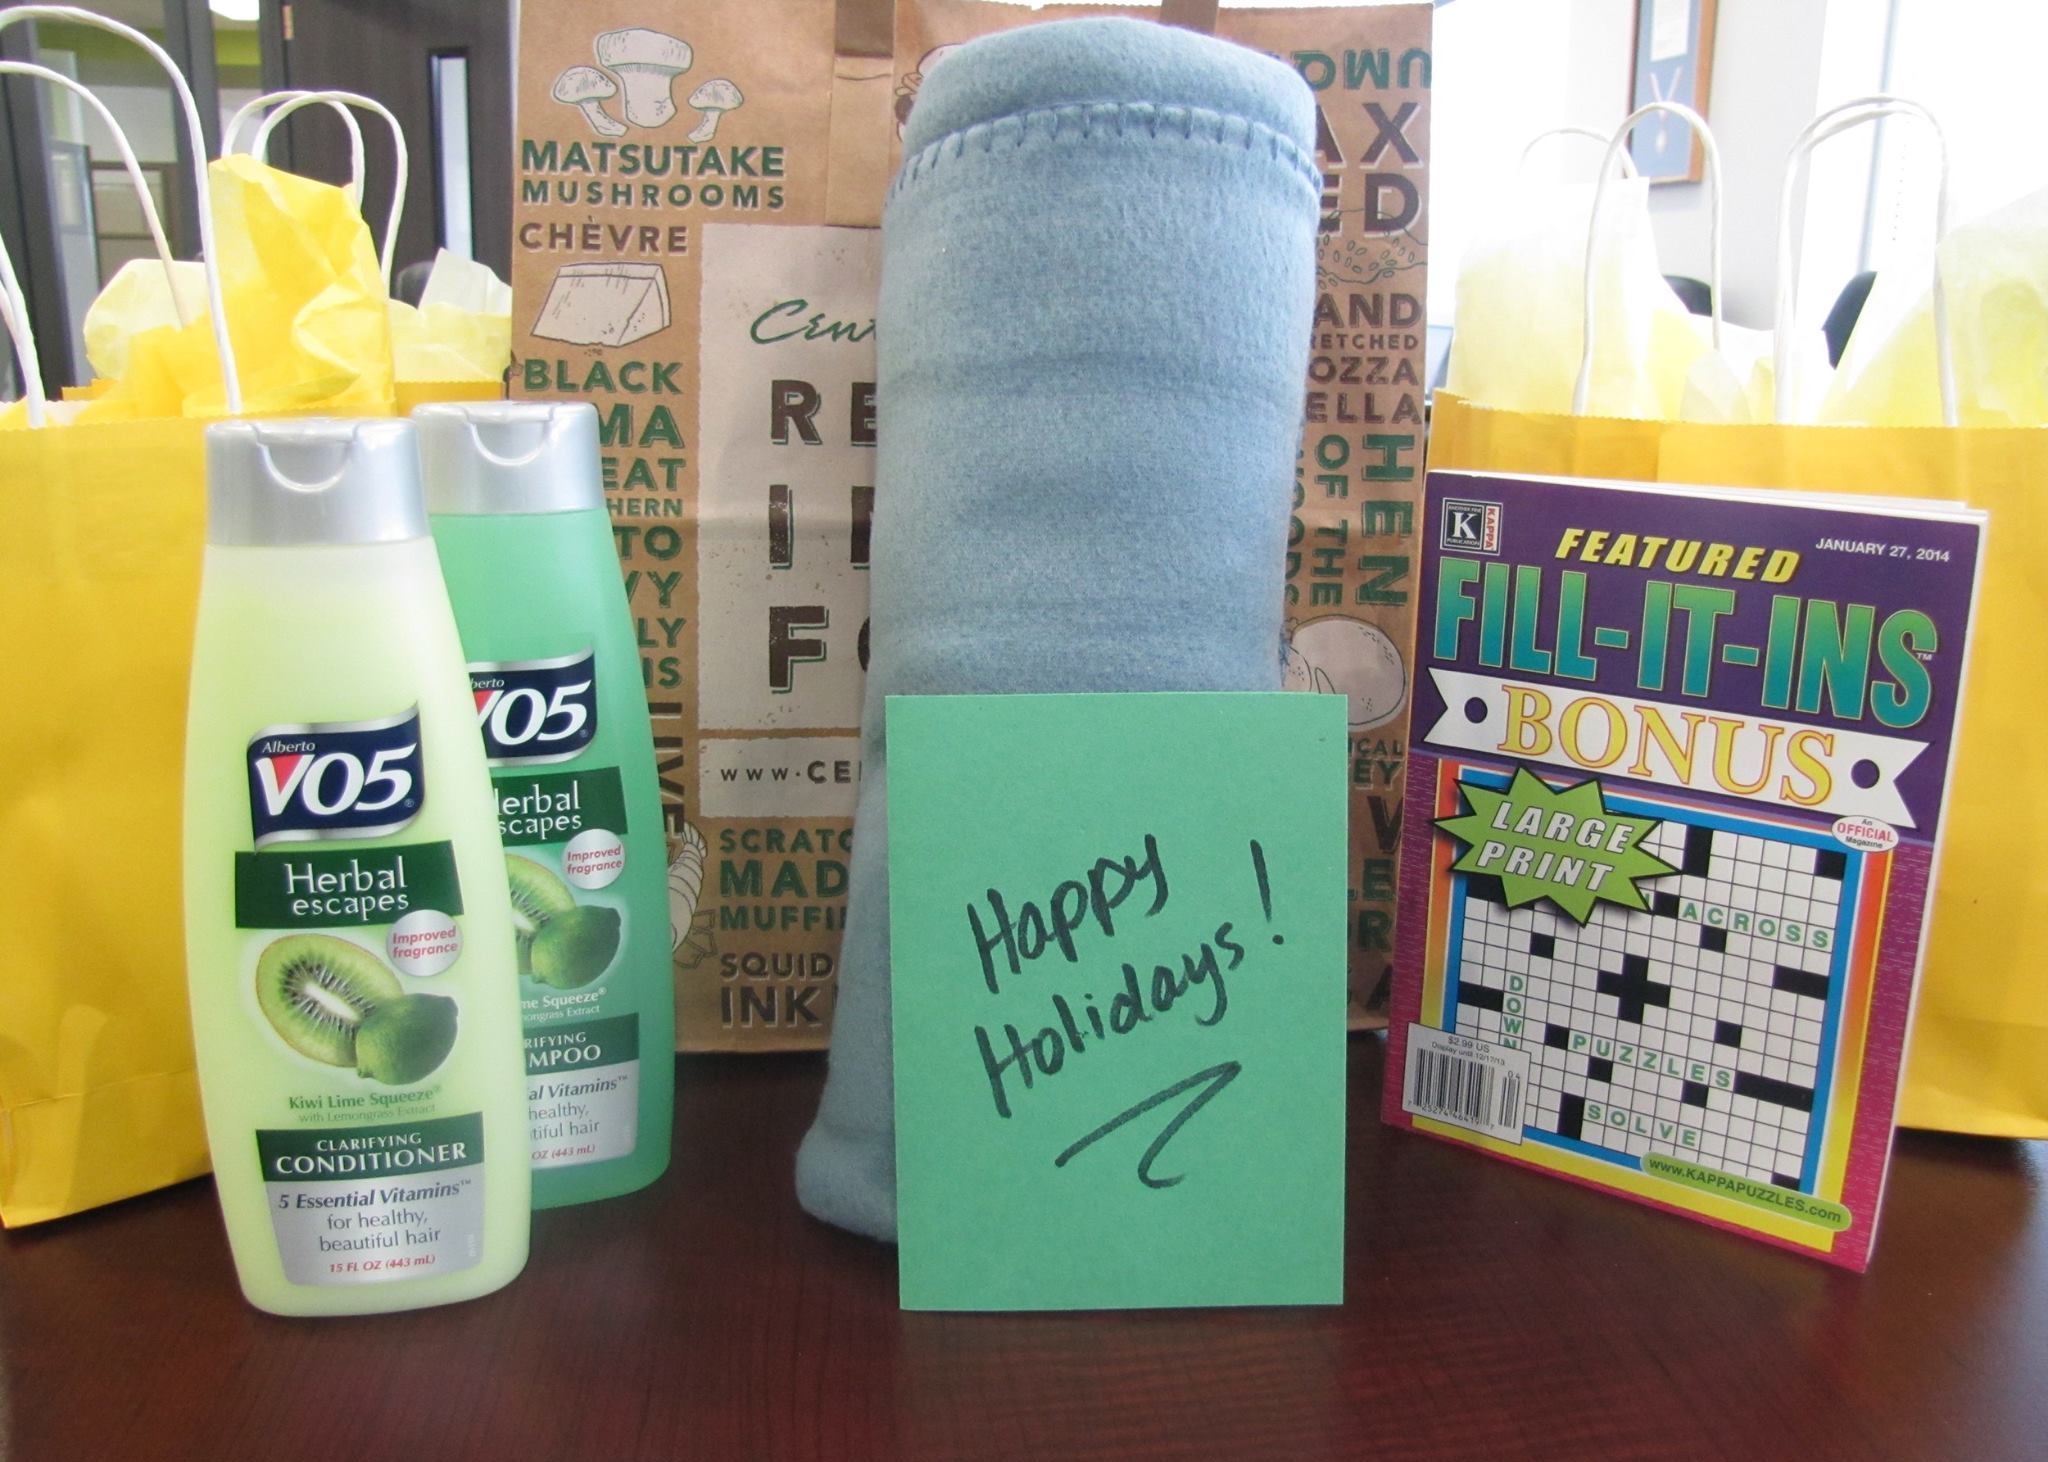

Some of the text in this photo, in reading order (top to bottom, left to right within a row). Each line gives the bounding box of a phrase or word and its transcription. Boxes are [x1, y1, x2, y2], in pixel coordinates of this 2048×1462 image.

[522, 139, 786, 179] MATSUTAKE
[522, 180, 785, 210] MUSHROOMS
[519, 215, 690, 254] CHÈVRE
[1313, 293, 1423, 328] AND
[523, 358, 684, 395] BLACK
[1308, 356, 1419, 385] OZZA
[1306, 392, 1422, 424] ELLA
[1310, 434, 1349, 606] OF THE
[1356, 434, 1415, 606] HEN
[1452, 512, 1477, 539] K
[1485, 507, 1496, 548] KAPPA
[612, 525, 683, 560] TO
[1555, 527, 1800, 584] FEATURED
[1815, 538, 1950, 562] JANUARY 27, 2014
[637, 618, 686, 648] LY
[262, 740, 315, 753] Alberto
[1497, 684, 1835, 806] BONUS
[1491, 801, 1634, 854] LARGE
[1837, 822, 1893, 843] OFFICIAL
[567, 845, 621, 861] Improved
[567, 859, 622, 875] fragrance
[1476, 840, 1615, 891] PRINT
[284, 856, 408, 894] Herbal
[720, 860, 850, 898] MAD
[292, 894, 409, 921] escapes
[967, 834, 1169, 995] Happy
[393, 925, 456, 945] Improved
[1682, 902, 1829, 949] ACROSS
[393, 943, 458, 959] fragrance
[720, 952, 834, 981] SQUID
[720, 986, 823, 1028] INK
[1476, 1043, 1490, 1053] US
[1572, 1034, 1731, 1087] PUZZLES
[289, 1095, 323, 1109] Kiwi
[328, 1094, 364, 1108] Lime
[298, 1111, 324, 1123] with
[570, 1120, 600, 1136] hair
[1587, 1104, 1697, 1147] SOLVE
[317, 1132, 422, 1151] CLARIFYING
[276, 1142, 467, 1175] CONDITIONER
[278, 1194, 289, 1209] 5
[296, 1189, 375, 1210] Essential
[1649, 1158, 1842, 1223] www.KAPPAPUZZLES.com
[327, 1208, 428, 1230] for healthy,
[320, 1228, 441, 1253] beautiful hair
[330, 1254, 436, 1273] 15 FL OZ (443 mL)
